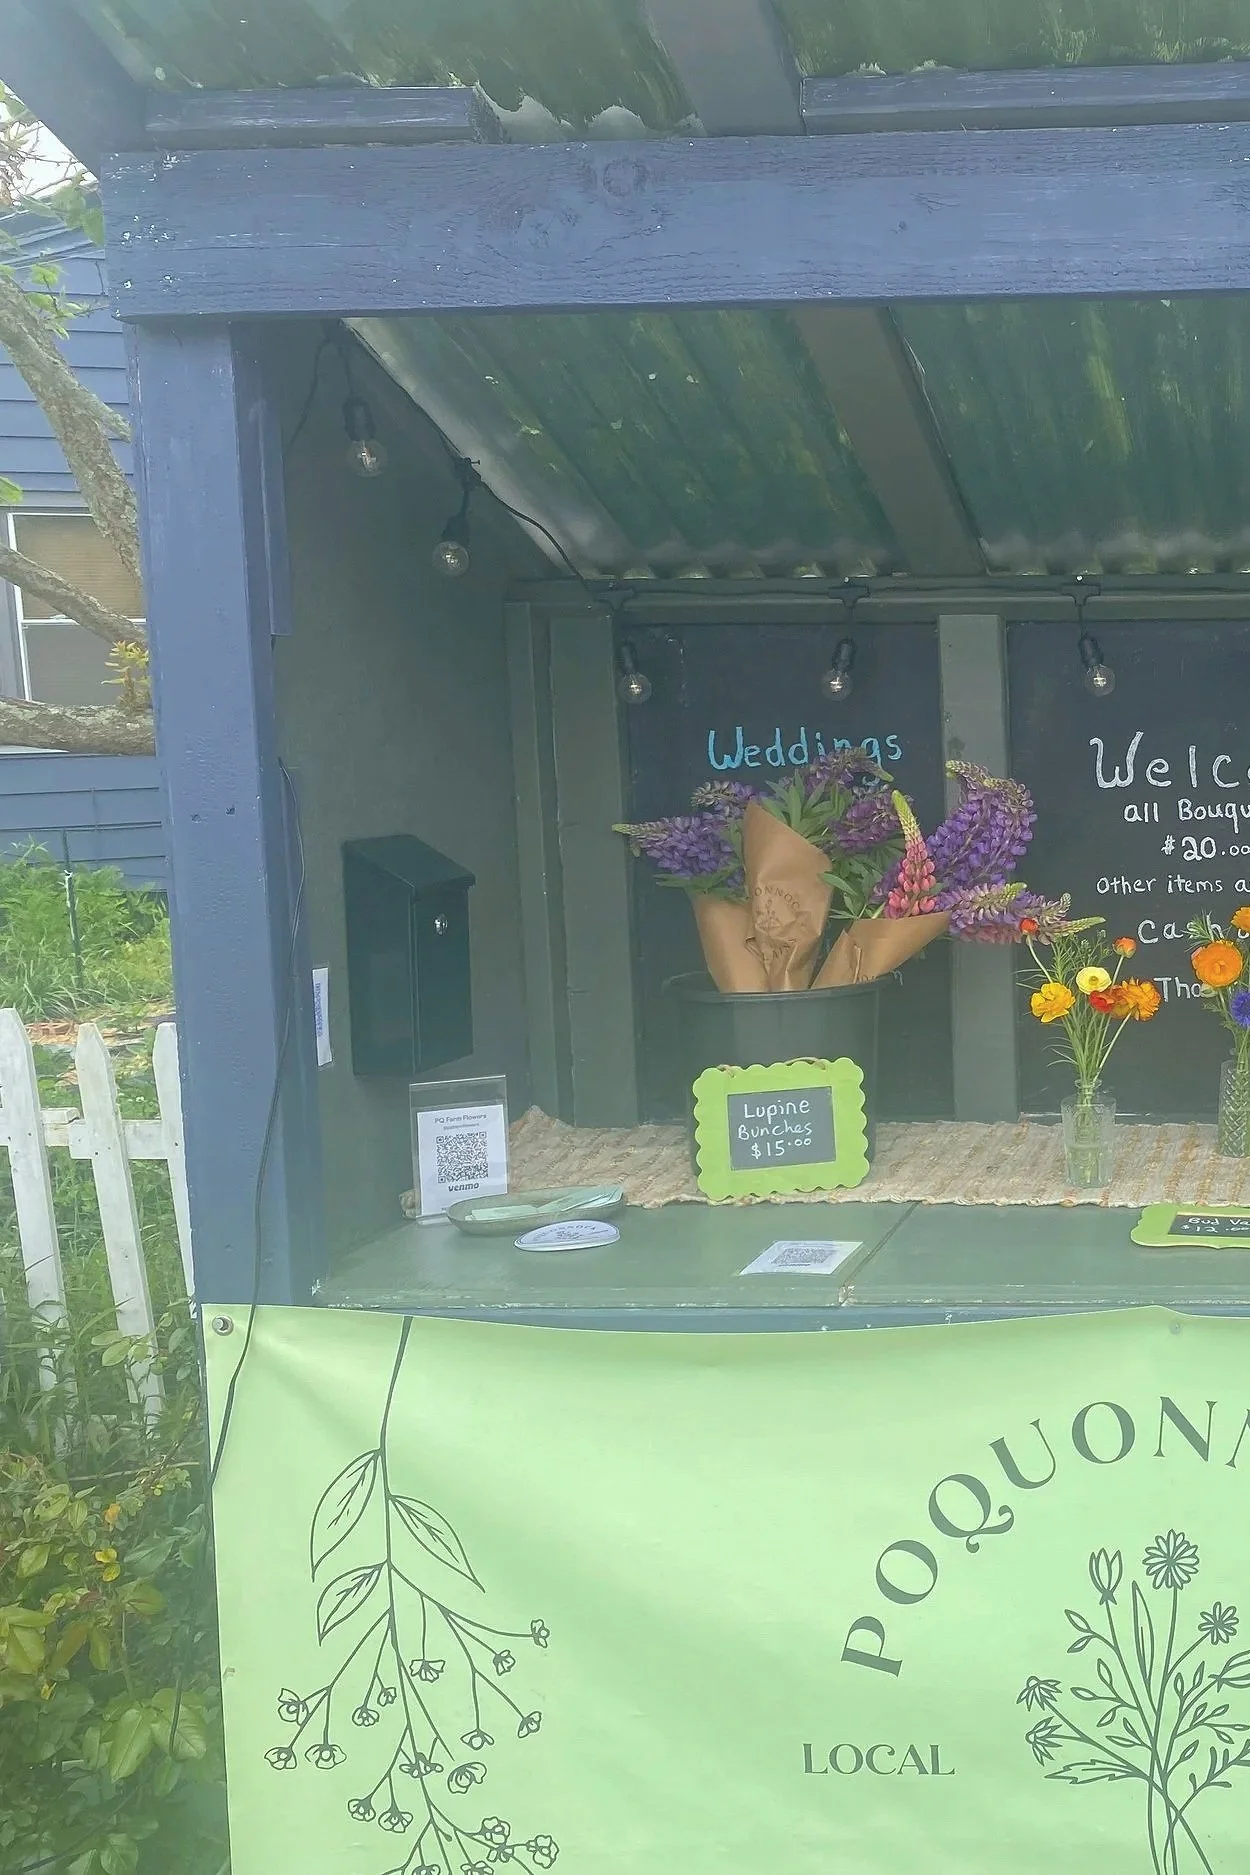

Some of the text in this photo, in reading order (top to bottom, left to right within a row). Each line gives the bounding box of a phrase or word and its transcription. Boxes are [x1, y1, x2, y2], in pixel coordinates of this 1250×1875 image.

[708, 726, 902, 788] Weddings
[1124, 801, 1158, 823] all
[1096, 875, 1156, 895] Other
[1168, 874, 1223, 894] items
[744, 1099, 811, 1125] Lupine
[738, 1120, 813, 1140] Bunches
[448, 1182, 480, 1192] venmo
[802, 1743, 956, 1777] LOCAL
